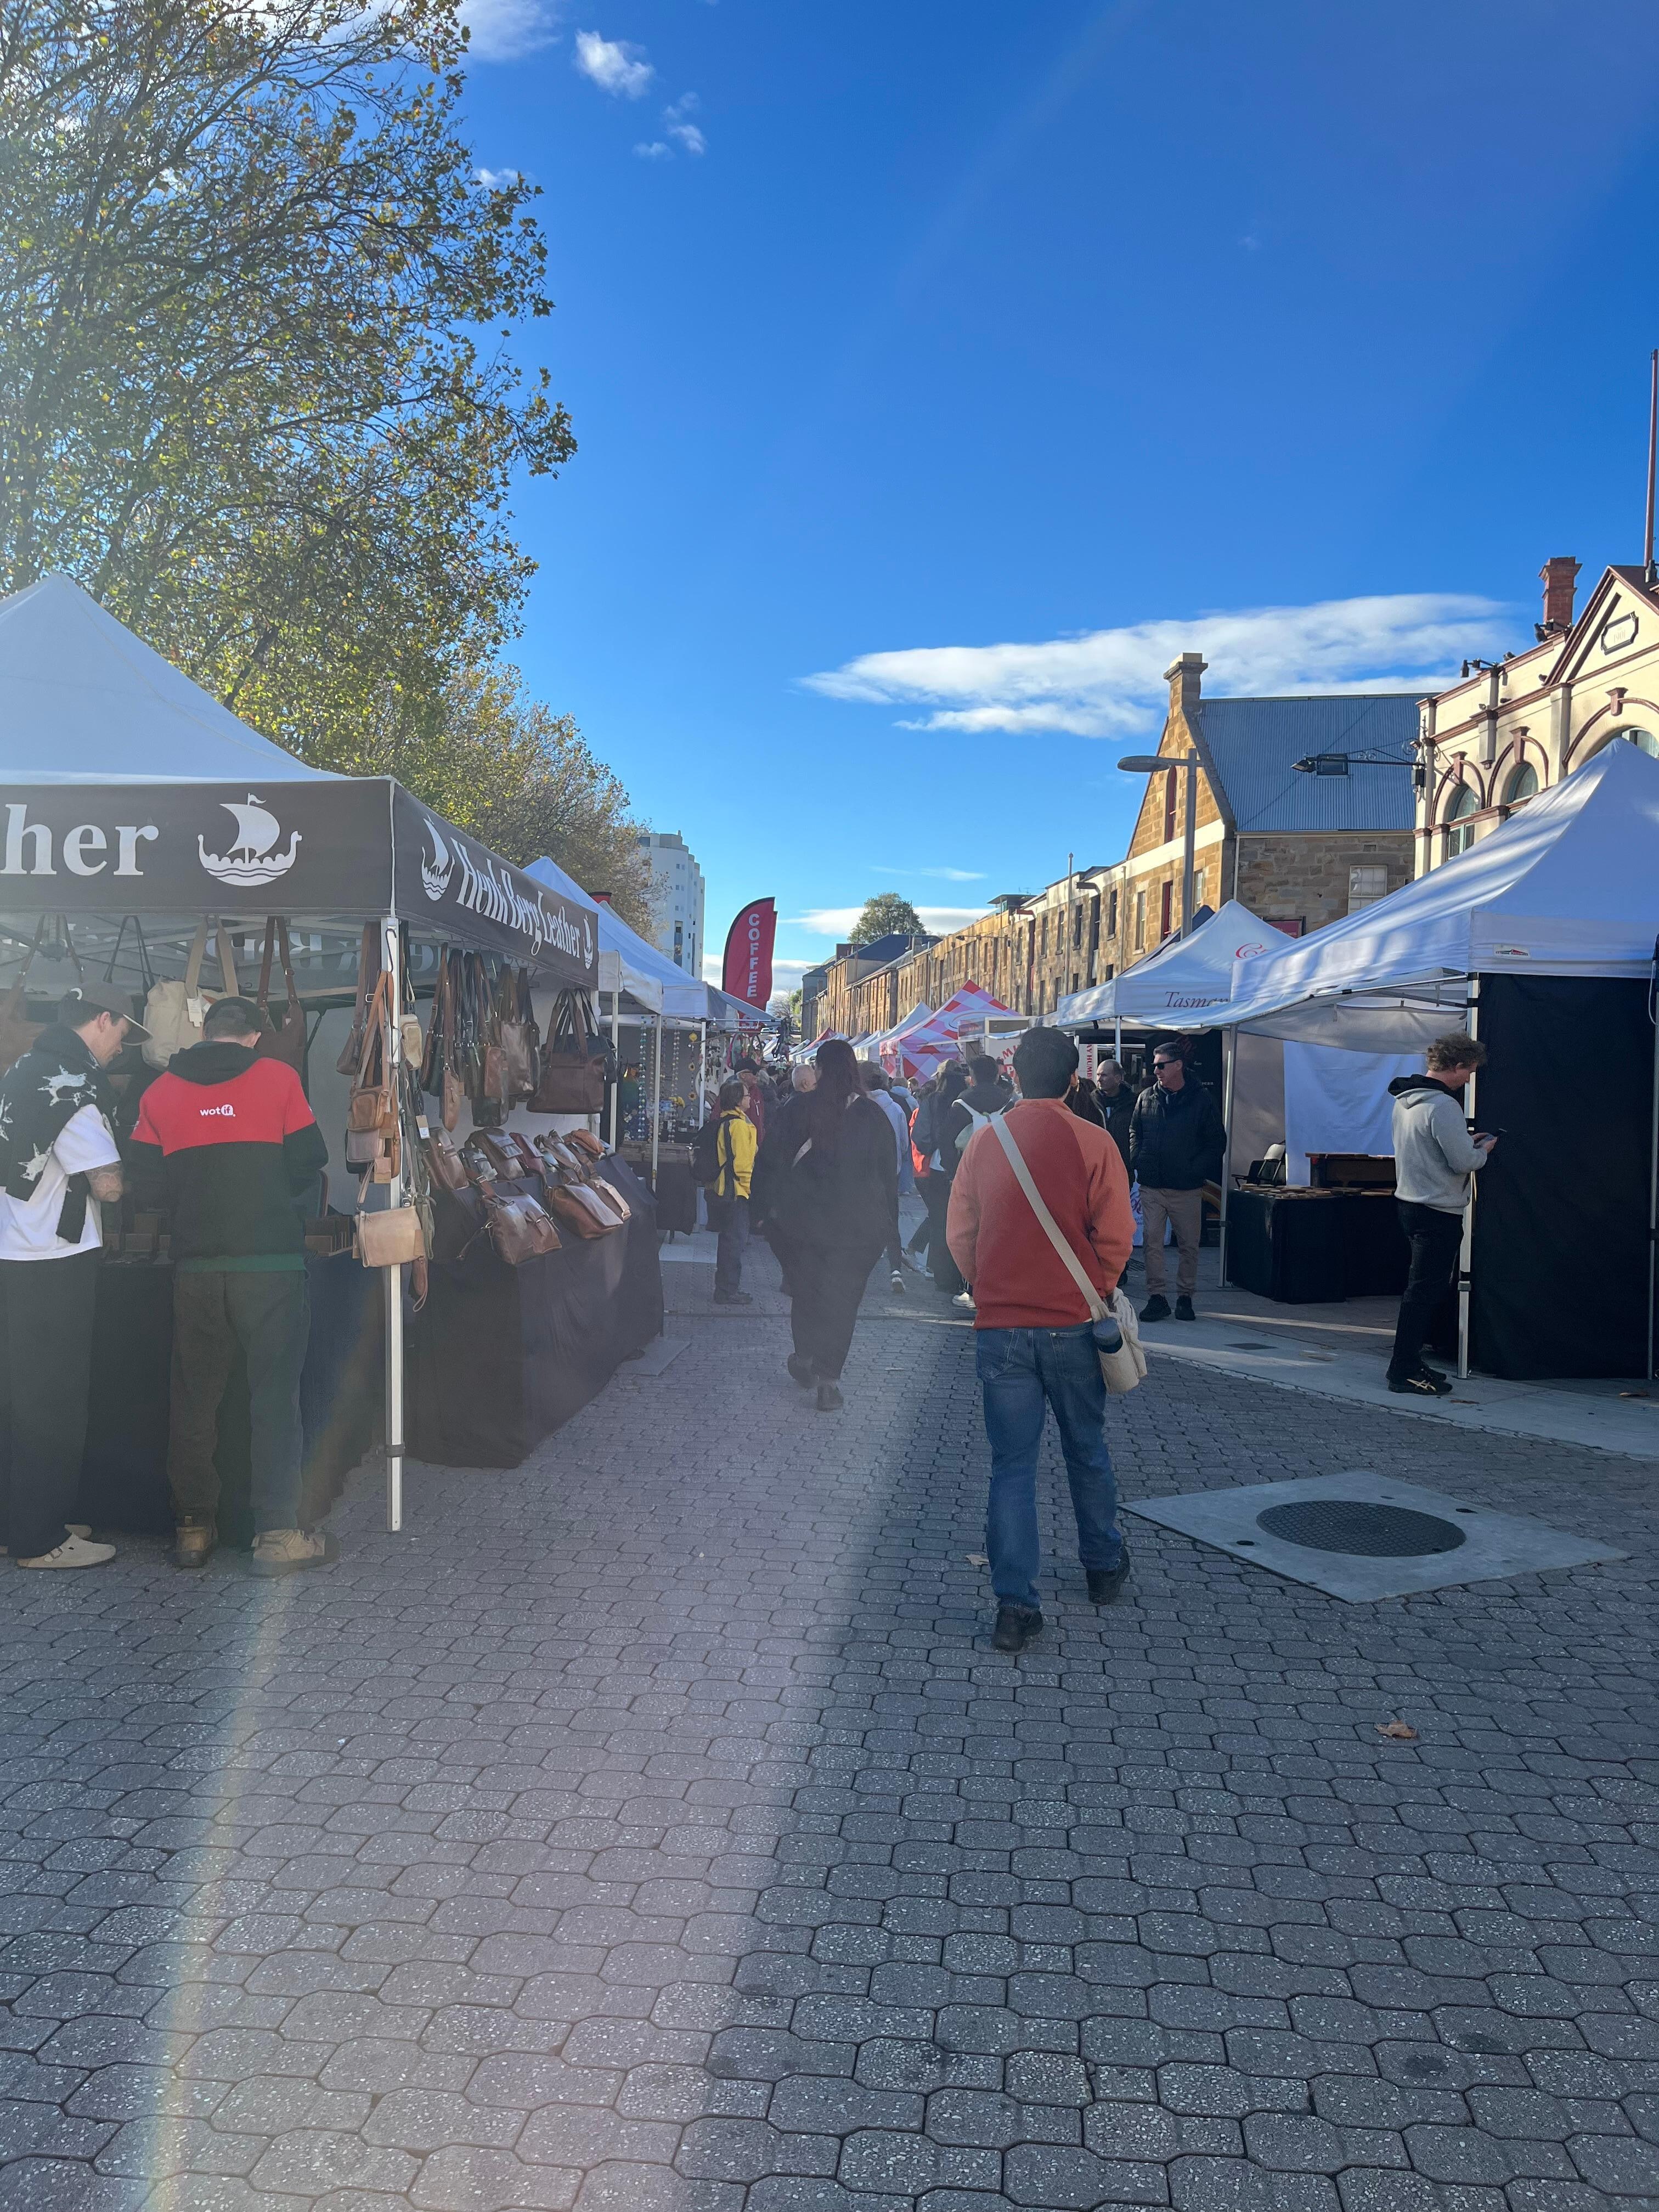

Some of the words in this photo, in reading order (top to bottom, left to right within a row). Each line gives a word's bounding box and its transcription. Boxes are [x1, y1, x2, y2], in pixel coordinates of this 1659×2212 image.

[0, 804, 159, 876] her
[450, 837, 507, 924] Henk
[500, 868, 542, 956] Berg
[538, 890, 580, 958] Leather
[747, 913, 760, 998] COFFEE
